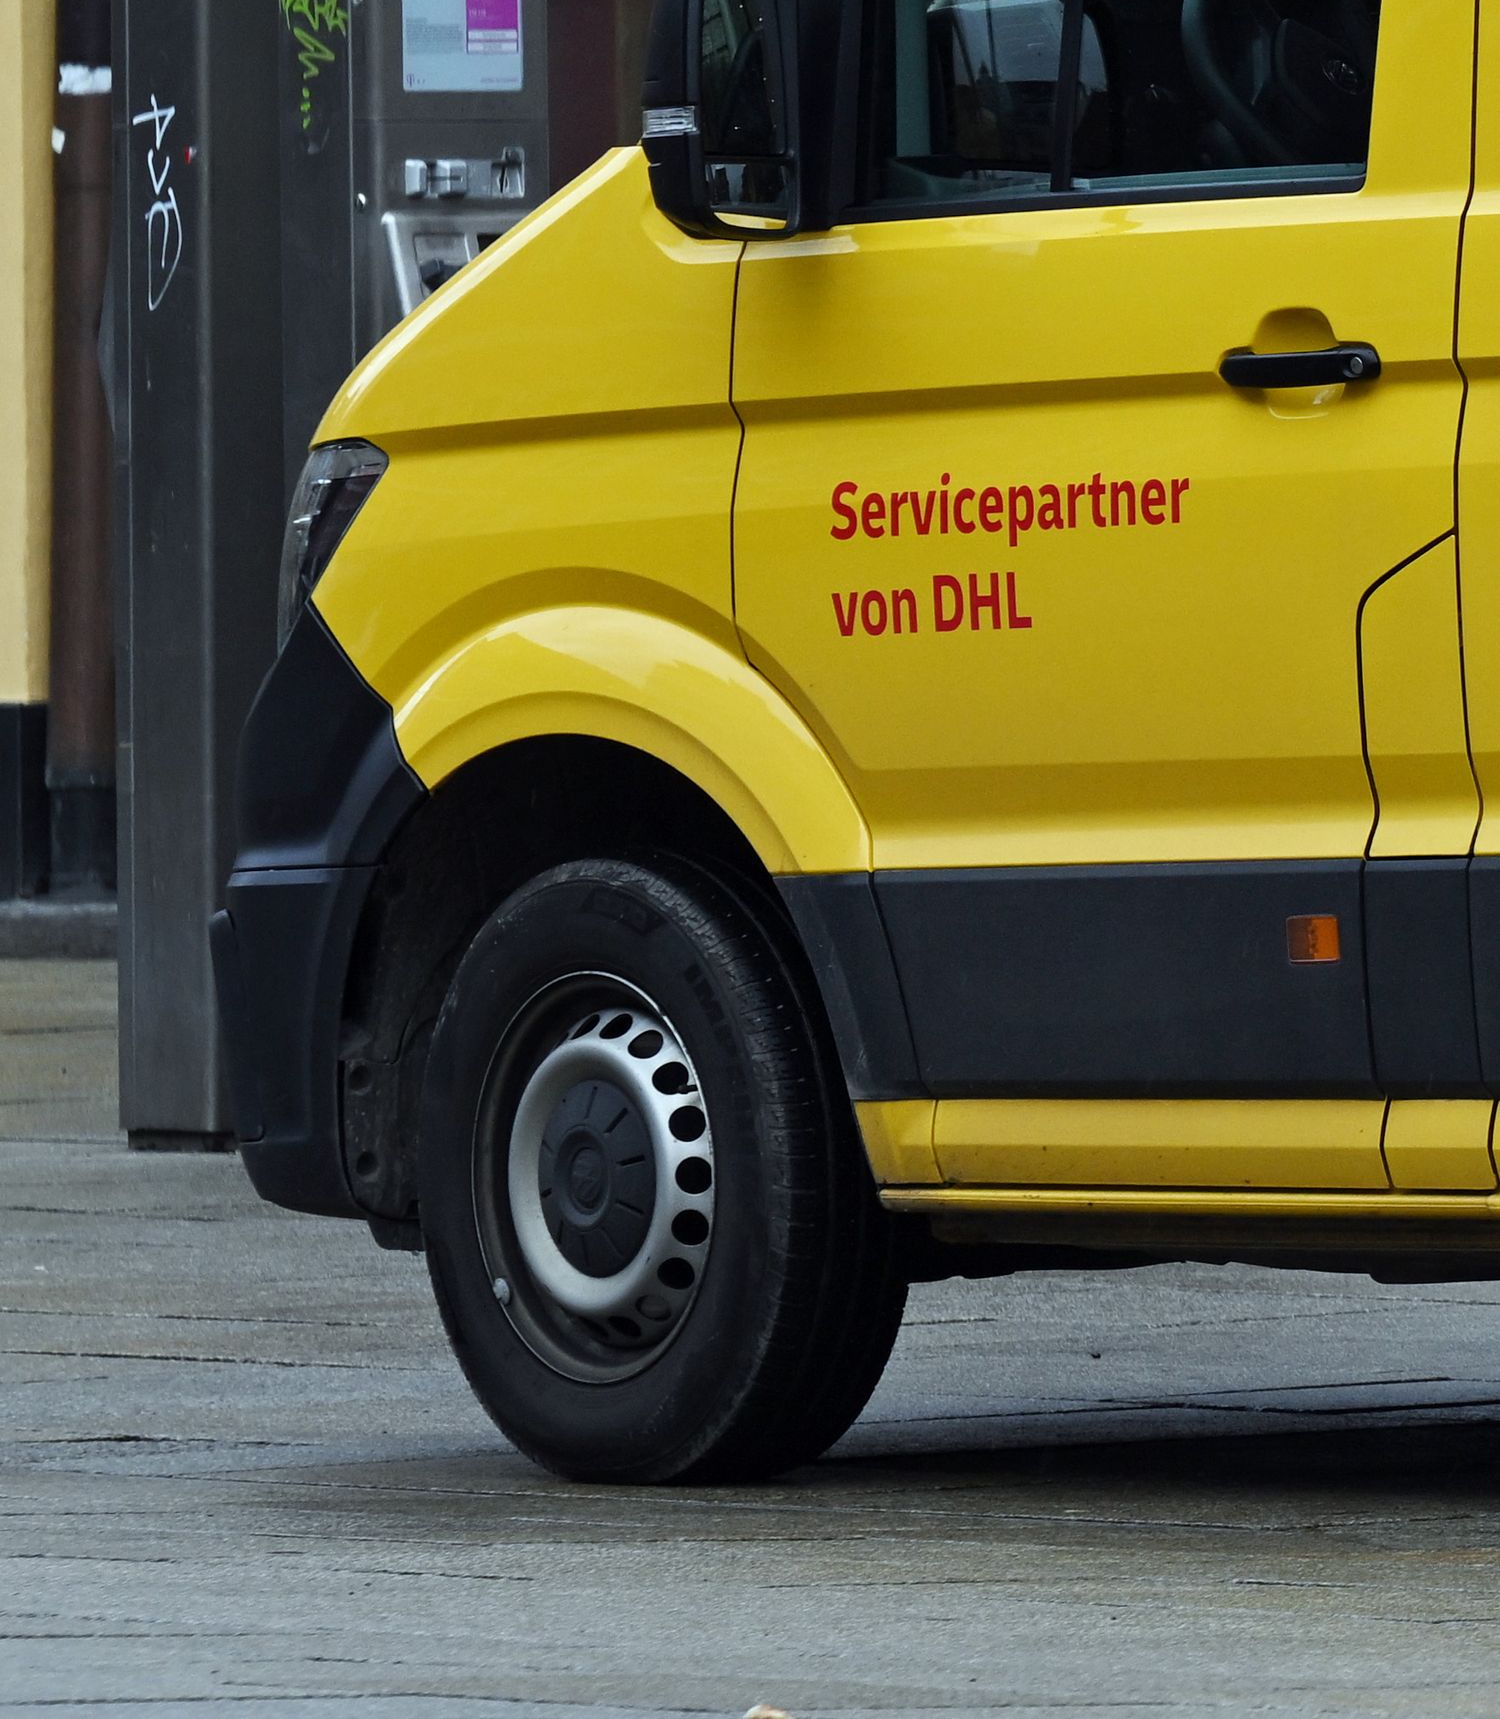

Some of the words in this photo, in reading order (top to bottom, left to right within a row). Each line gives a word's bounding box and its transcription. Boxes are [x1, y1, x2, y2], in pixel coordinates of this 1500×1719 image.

[830, 472, 1190, 548] Servicepartner
[831, 586, 919, 637] von
[932, 570, 1033, 633] DHL
